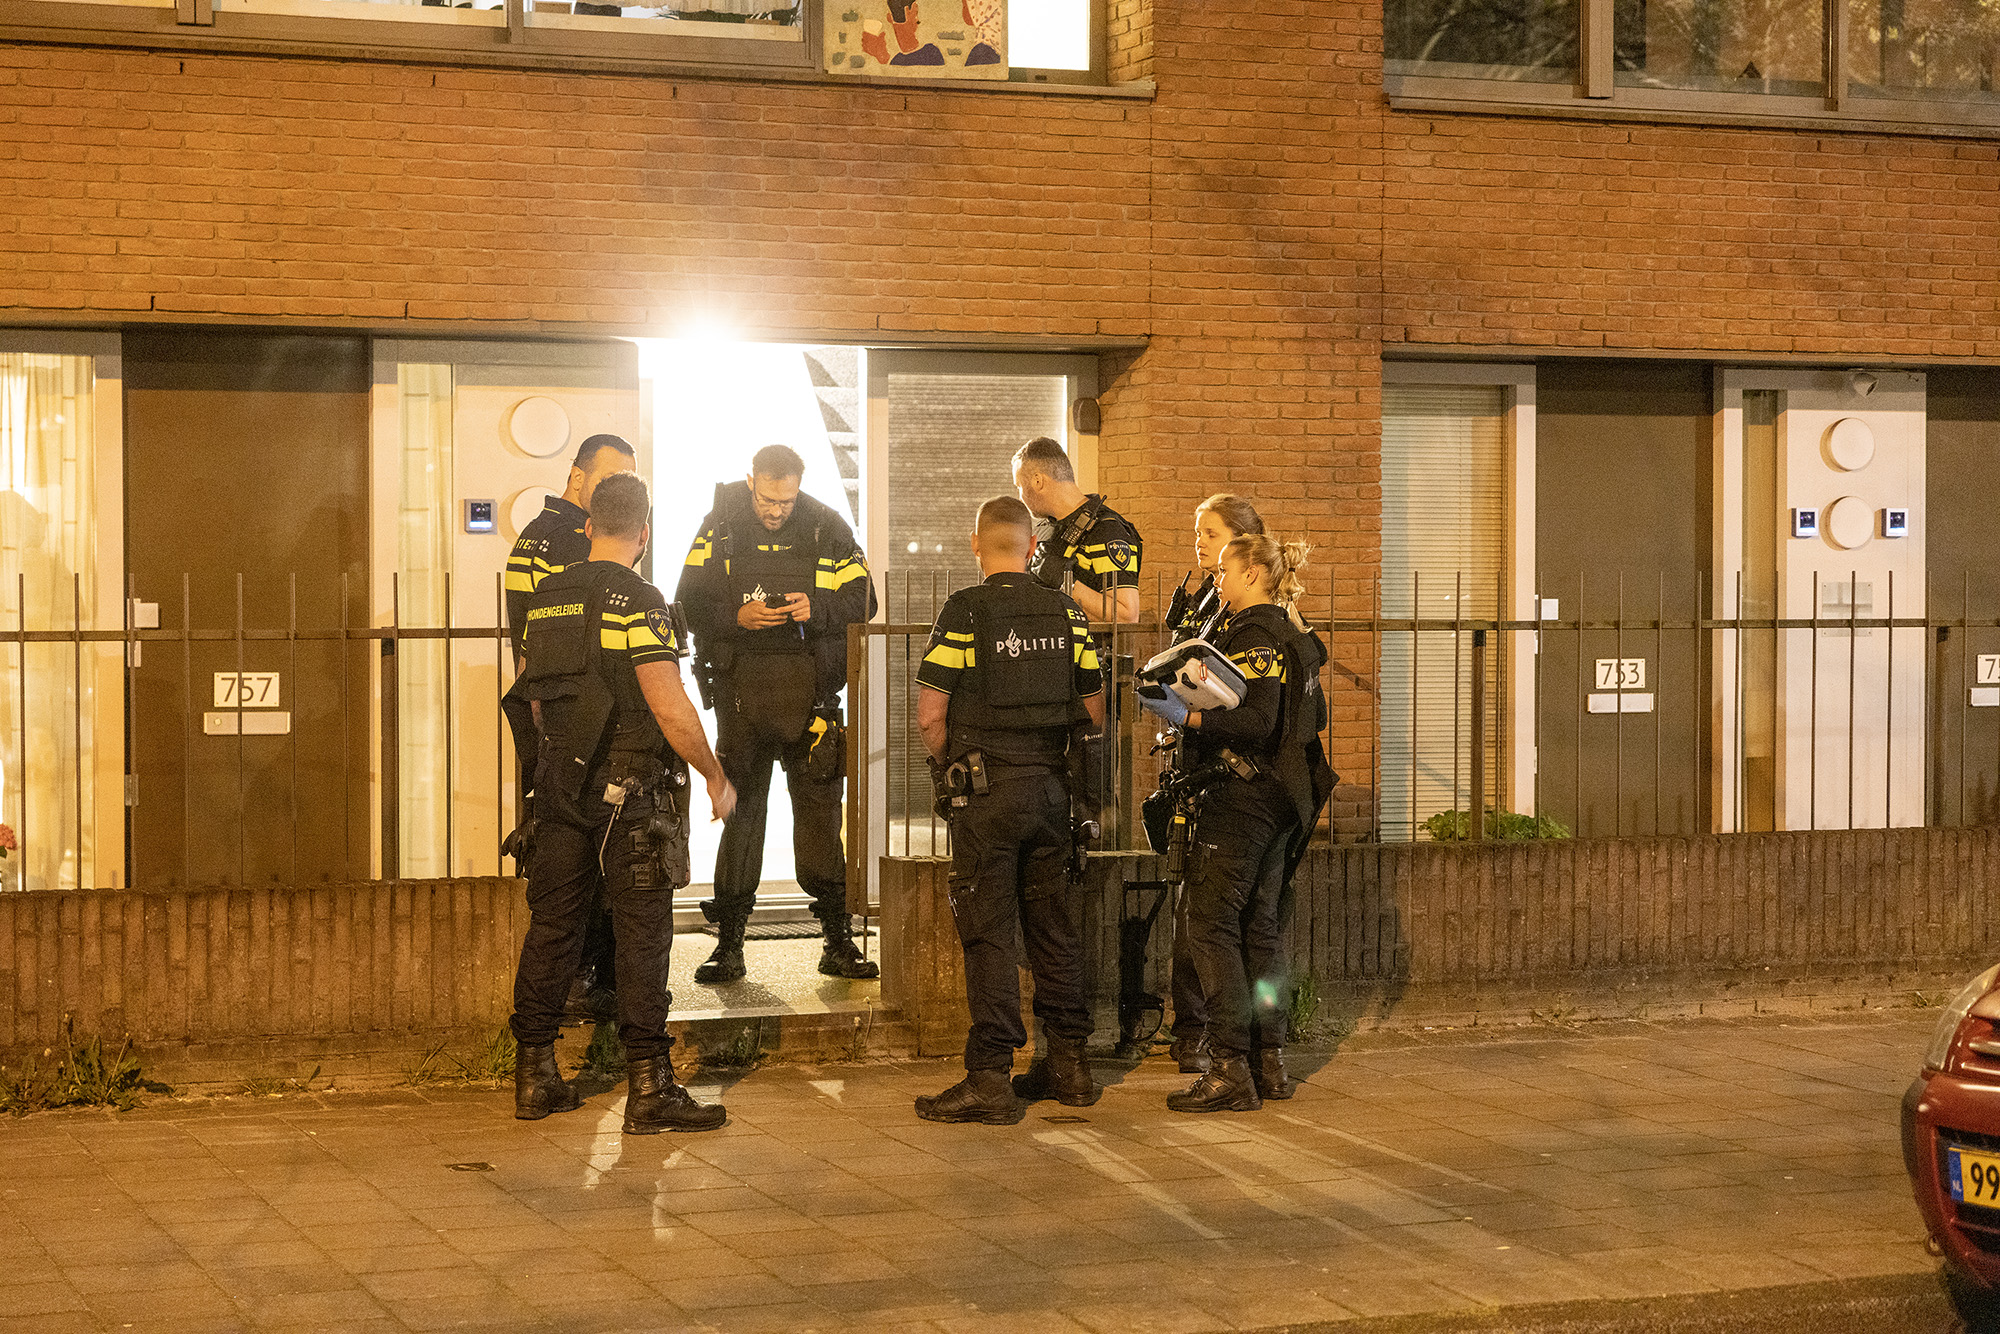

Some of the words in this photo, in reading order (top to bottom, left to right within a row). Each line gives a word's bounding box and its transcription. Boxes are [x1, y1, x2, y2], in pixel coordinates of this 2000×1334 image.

[527, 603, 584, 621] HONDENGELEIDER
[1600, 662, 1640, 685] 753
[1984, 658, 2000, 679] 7
[221, 677, 272, 702] 757
[1952, 1180, 1962, 1192] NL
[1970, 1161, 2000, 1201] 99
